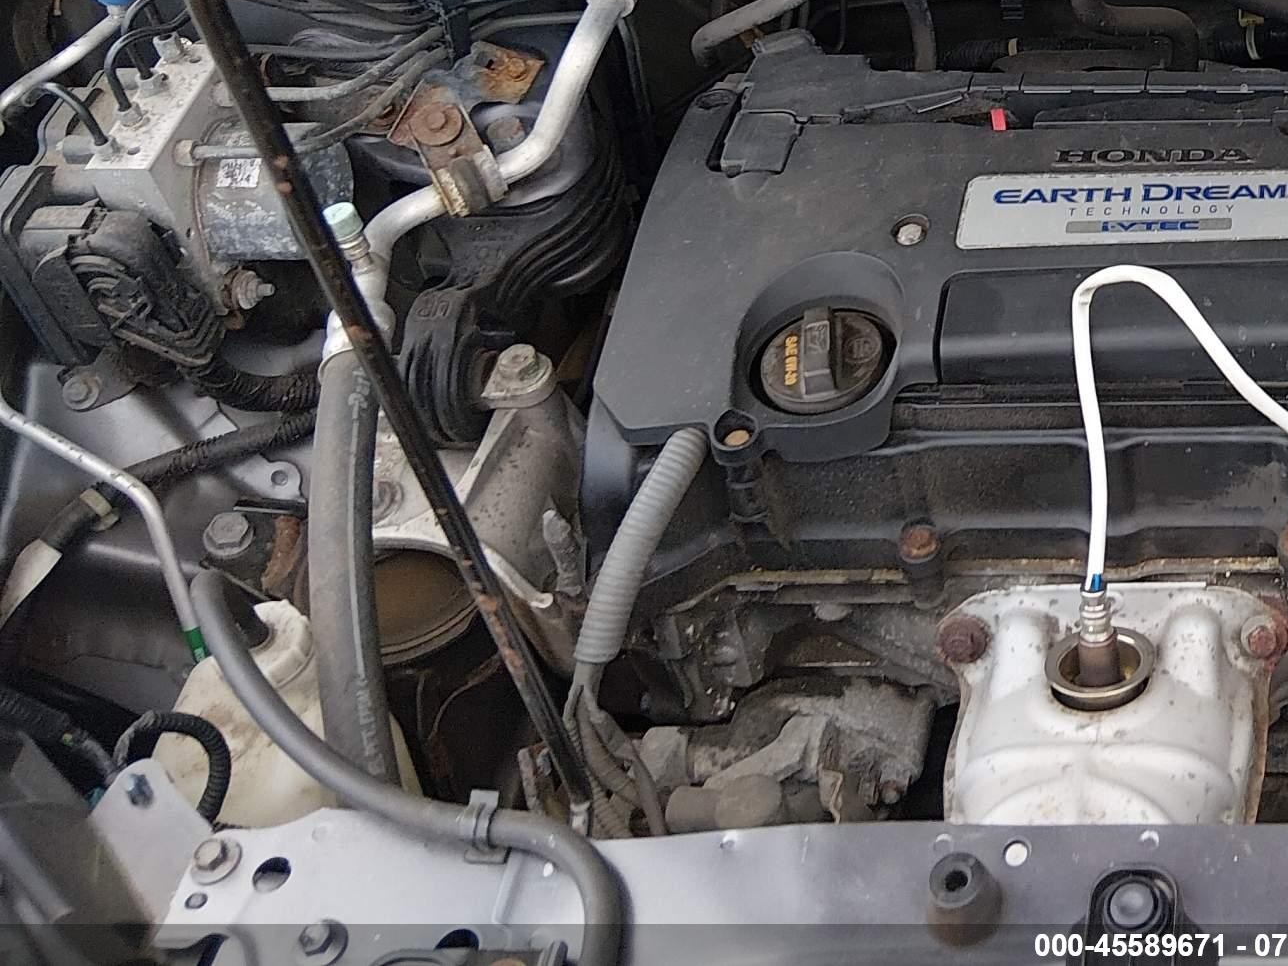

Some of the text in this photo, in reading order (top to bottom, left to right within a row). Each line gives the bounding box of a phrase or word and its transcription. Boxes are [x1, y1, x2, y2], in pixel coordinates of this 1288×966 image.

[1054, 148, 1256, 166] HONDA
[993, 187, 1132, 204] EARTH
[1068, 204, 1236, 217] TECHNOLOGY
[1101, 220, 1200, 232] i-VTEC
[784, 335, 799, 357] SAE
